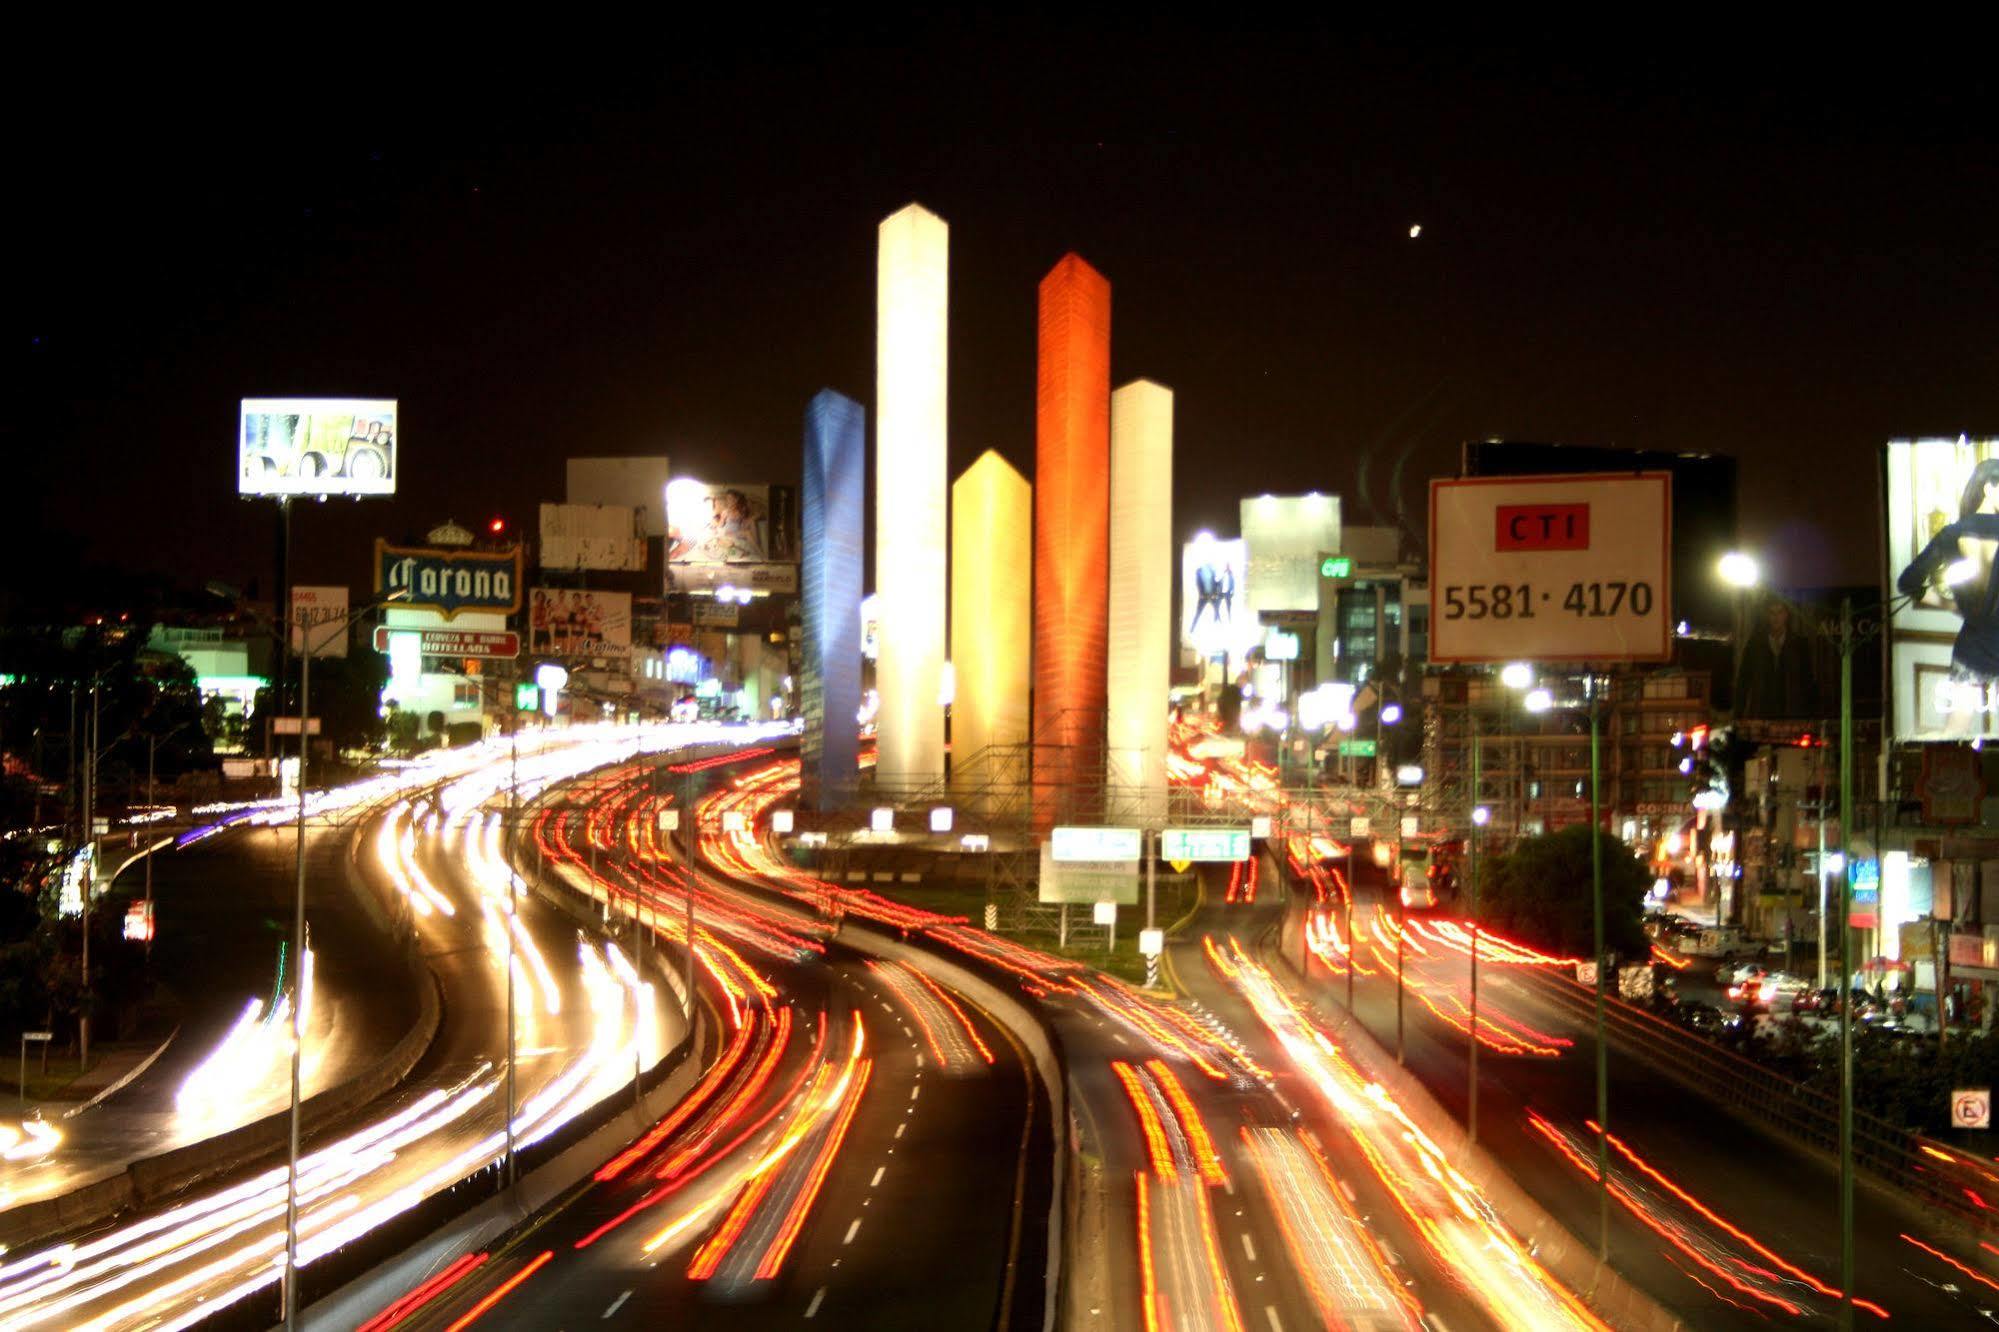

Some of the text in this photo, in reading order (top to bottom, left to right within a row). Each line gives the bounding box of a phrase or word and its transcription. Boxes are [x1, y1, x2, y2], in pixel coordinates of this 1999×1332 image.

[1509, 514, 1575, 541] CTI
[388, 557, 512, 602] Corona
[1563, 582, 1652, 617] 4170
